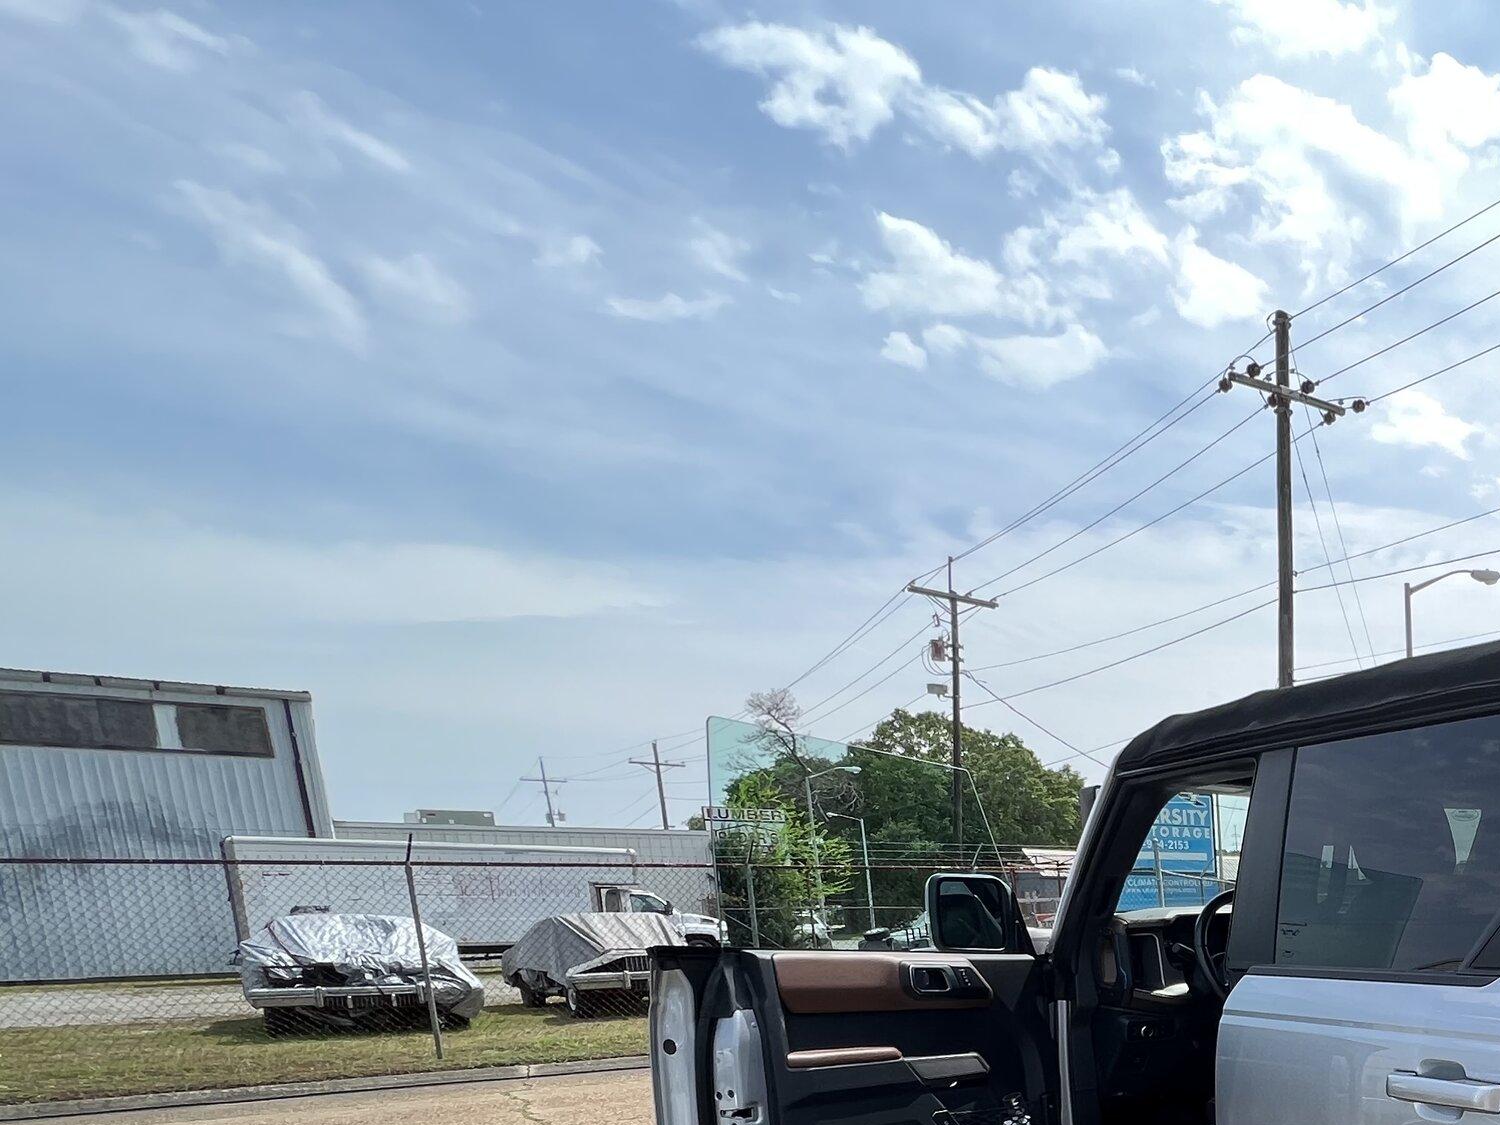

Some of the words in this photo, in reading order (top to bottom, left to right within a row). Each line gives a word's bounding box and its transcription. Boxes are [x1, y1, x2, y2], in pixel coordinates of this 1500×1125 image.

[706, 808, 784, 820] LUMBER
[1154, 808, 1208, 826] RSITY
[1127, 879, 1157, 887] CLIMAT
